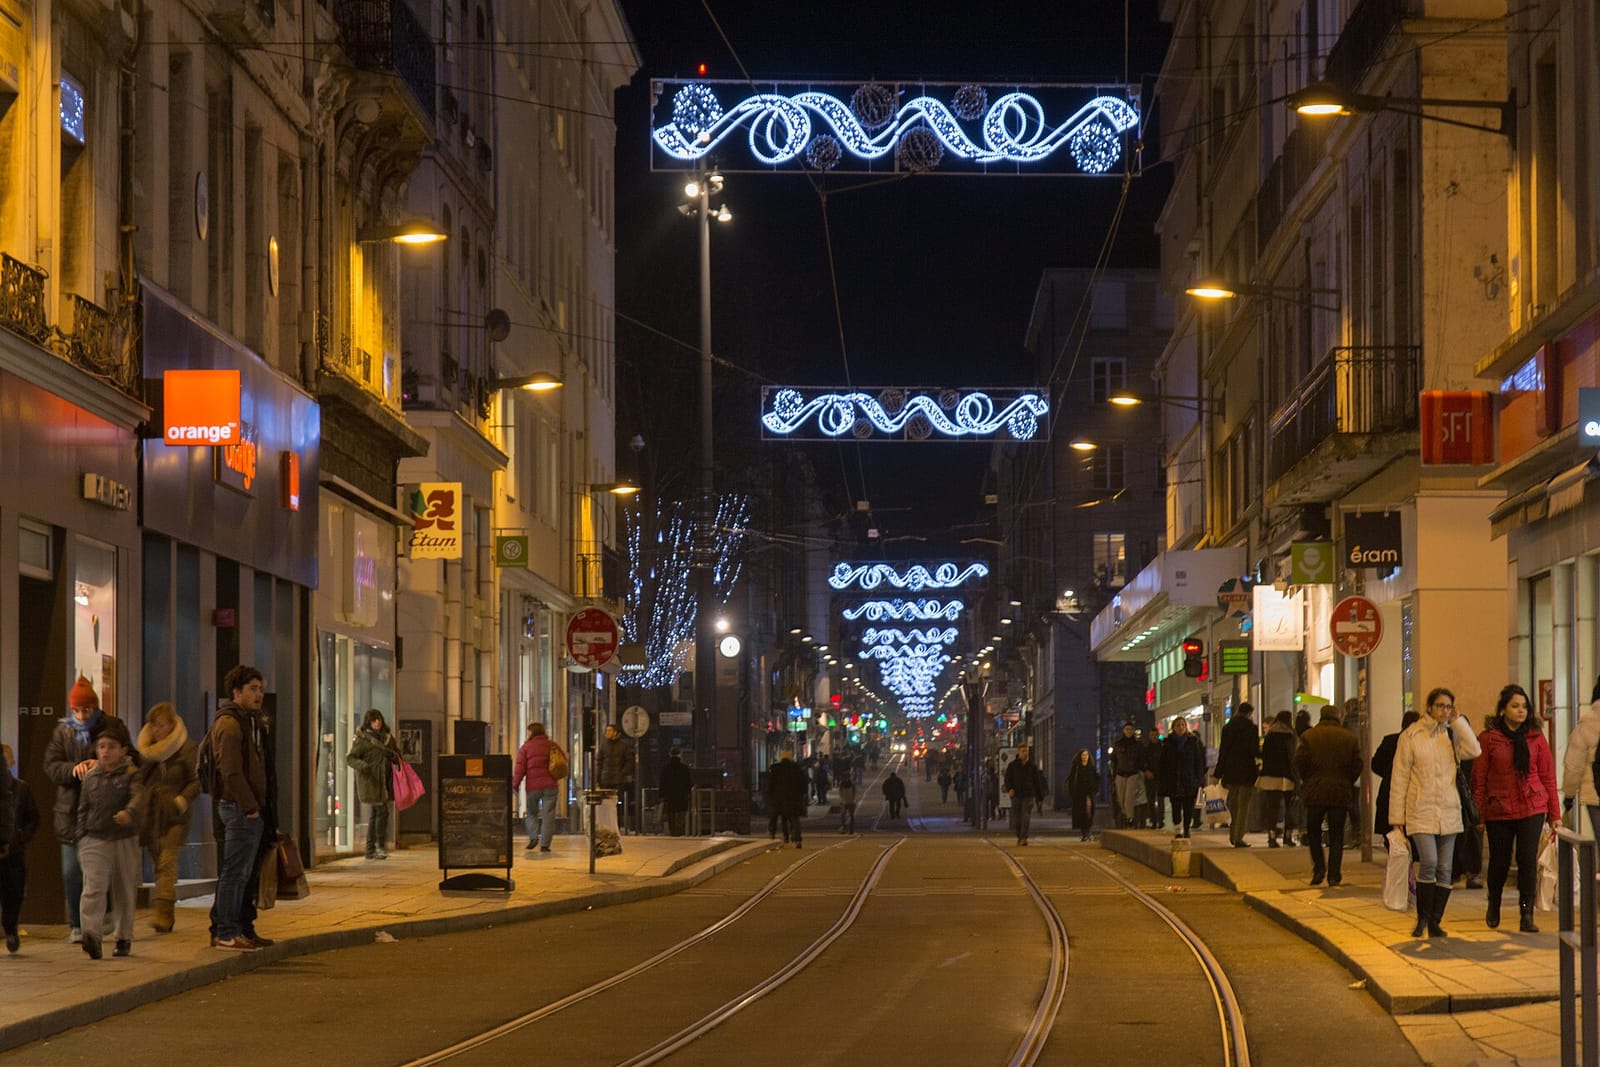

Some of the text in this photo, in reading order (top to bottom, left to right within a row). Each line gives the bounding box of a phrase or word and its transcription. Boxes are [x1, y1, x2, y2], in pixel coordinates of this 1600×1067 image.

[167, 424, 232, 443] orange
[408, 532, 456, 546] Etam
[1350, 545, 1398, 563] éram
